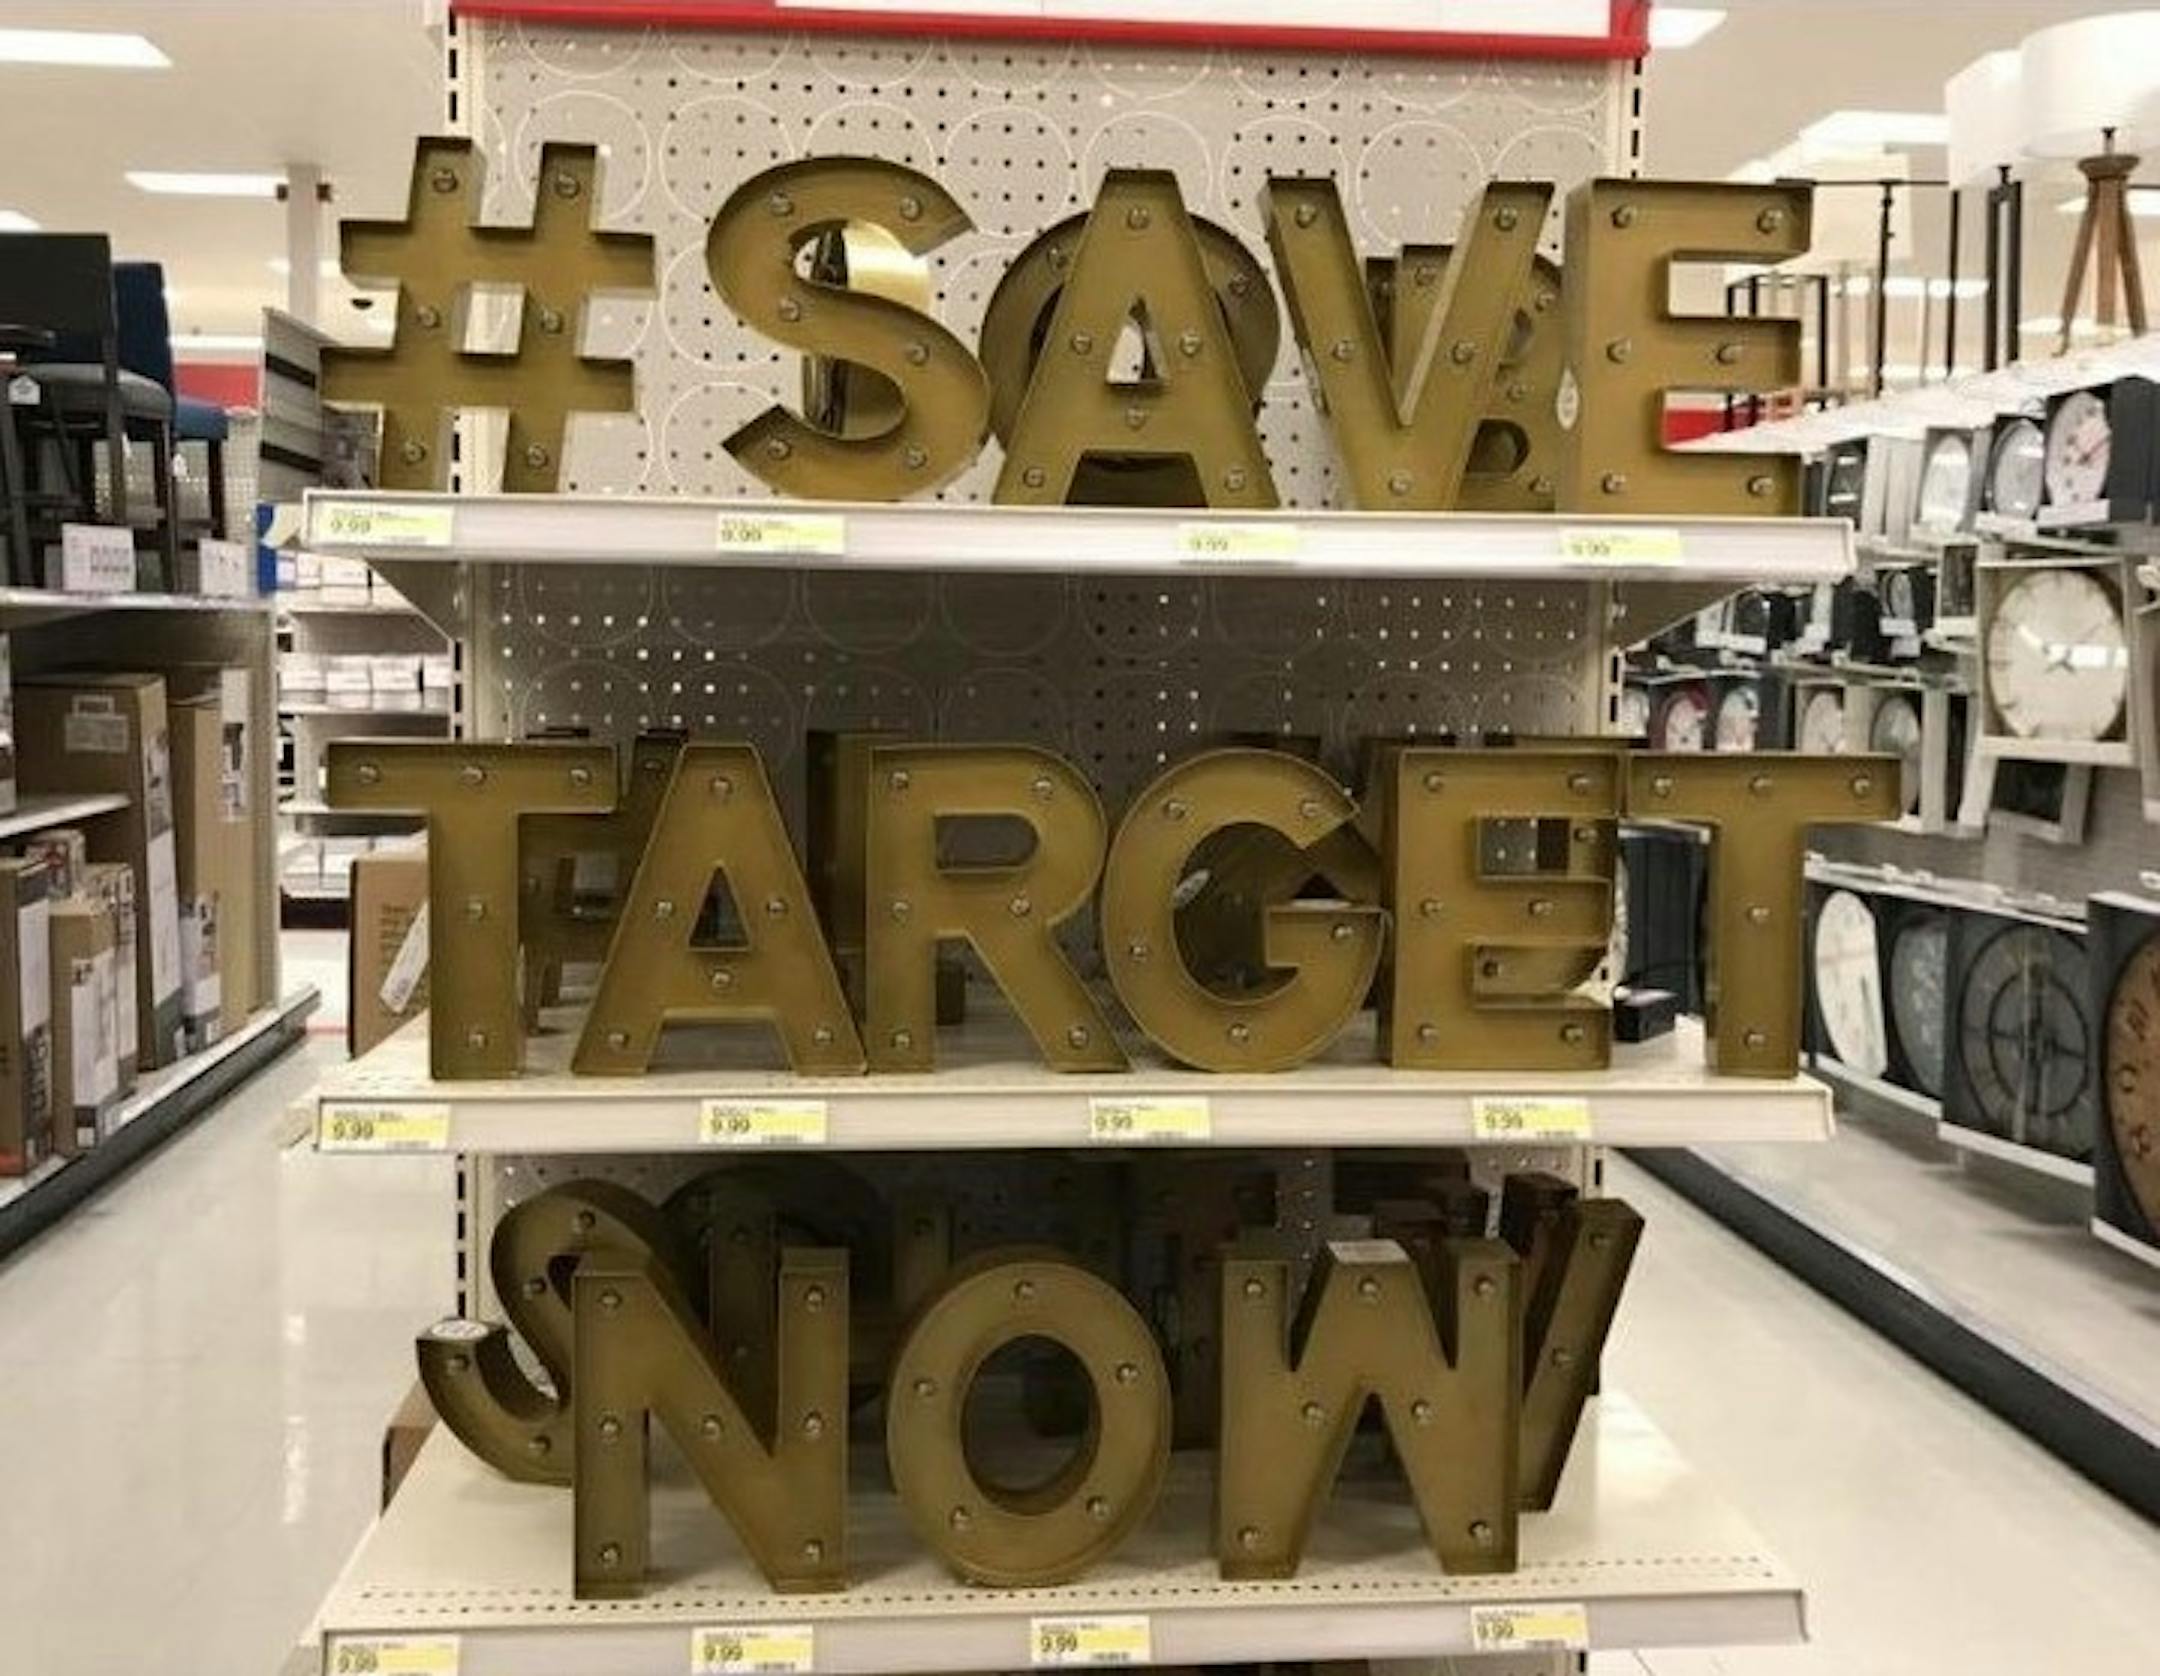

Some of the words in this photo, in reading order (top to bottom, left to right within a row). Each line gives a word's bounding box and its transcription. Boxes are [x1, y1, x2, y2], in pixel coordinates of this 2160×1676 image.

[321, 136, 1812, 514] #SAVE
[328, 741, 1901, 1080] TARGET
[332, 1118, 374, 1140] 9.99
[709, 1116, 751, 1135] 9.99
[1094, 1112, 1133, 1132] 9.99
[1484, 1111, 1523, 1130] 9.99
[572, 1239, 1522, 1600] NOW
[1476, 1620, 1514, 1640] 9.99
[1039, 1632, 1078, 1652] 9.99
[703, 1644, 744, 1662] 9.99
[337, 1654, 379, 1674] 9.99
